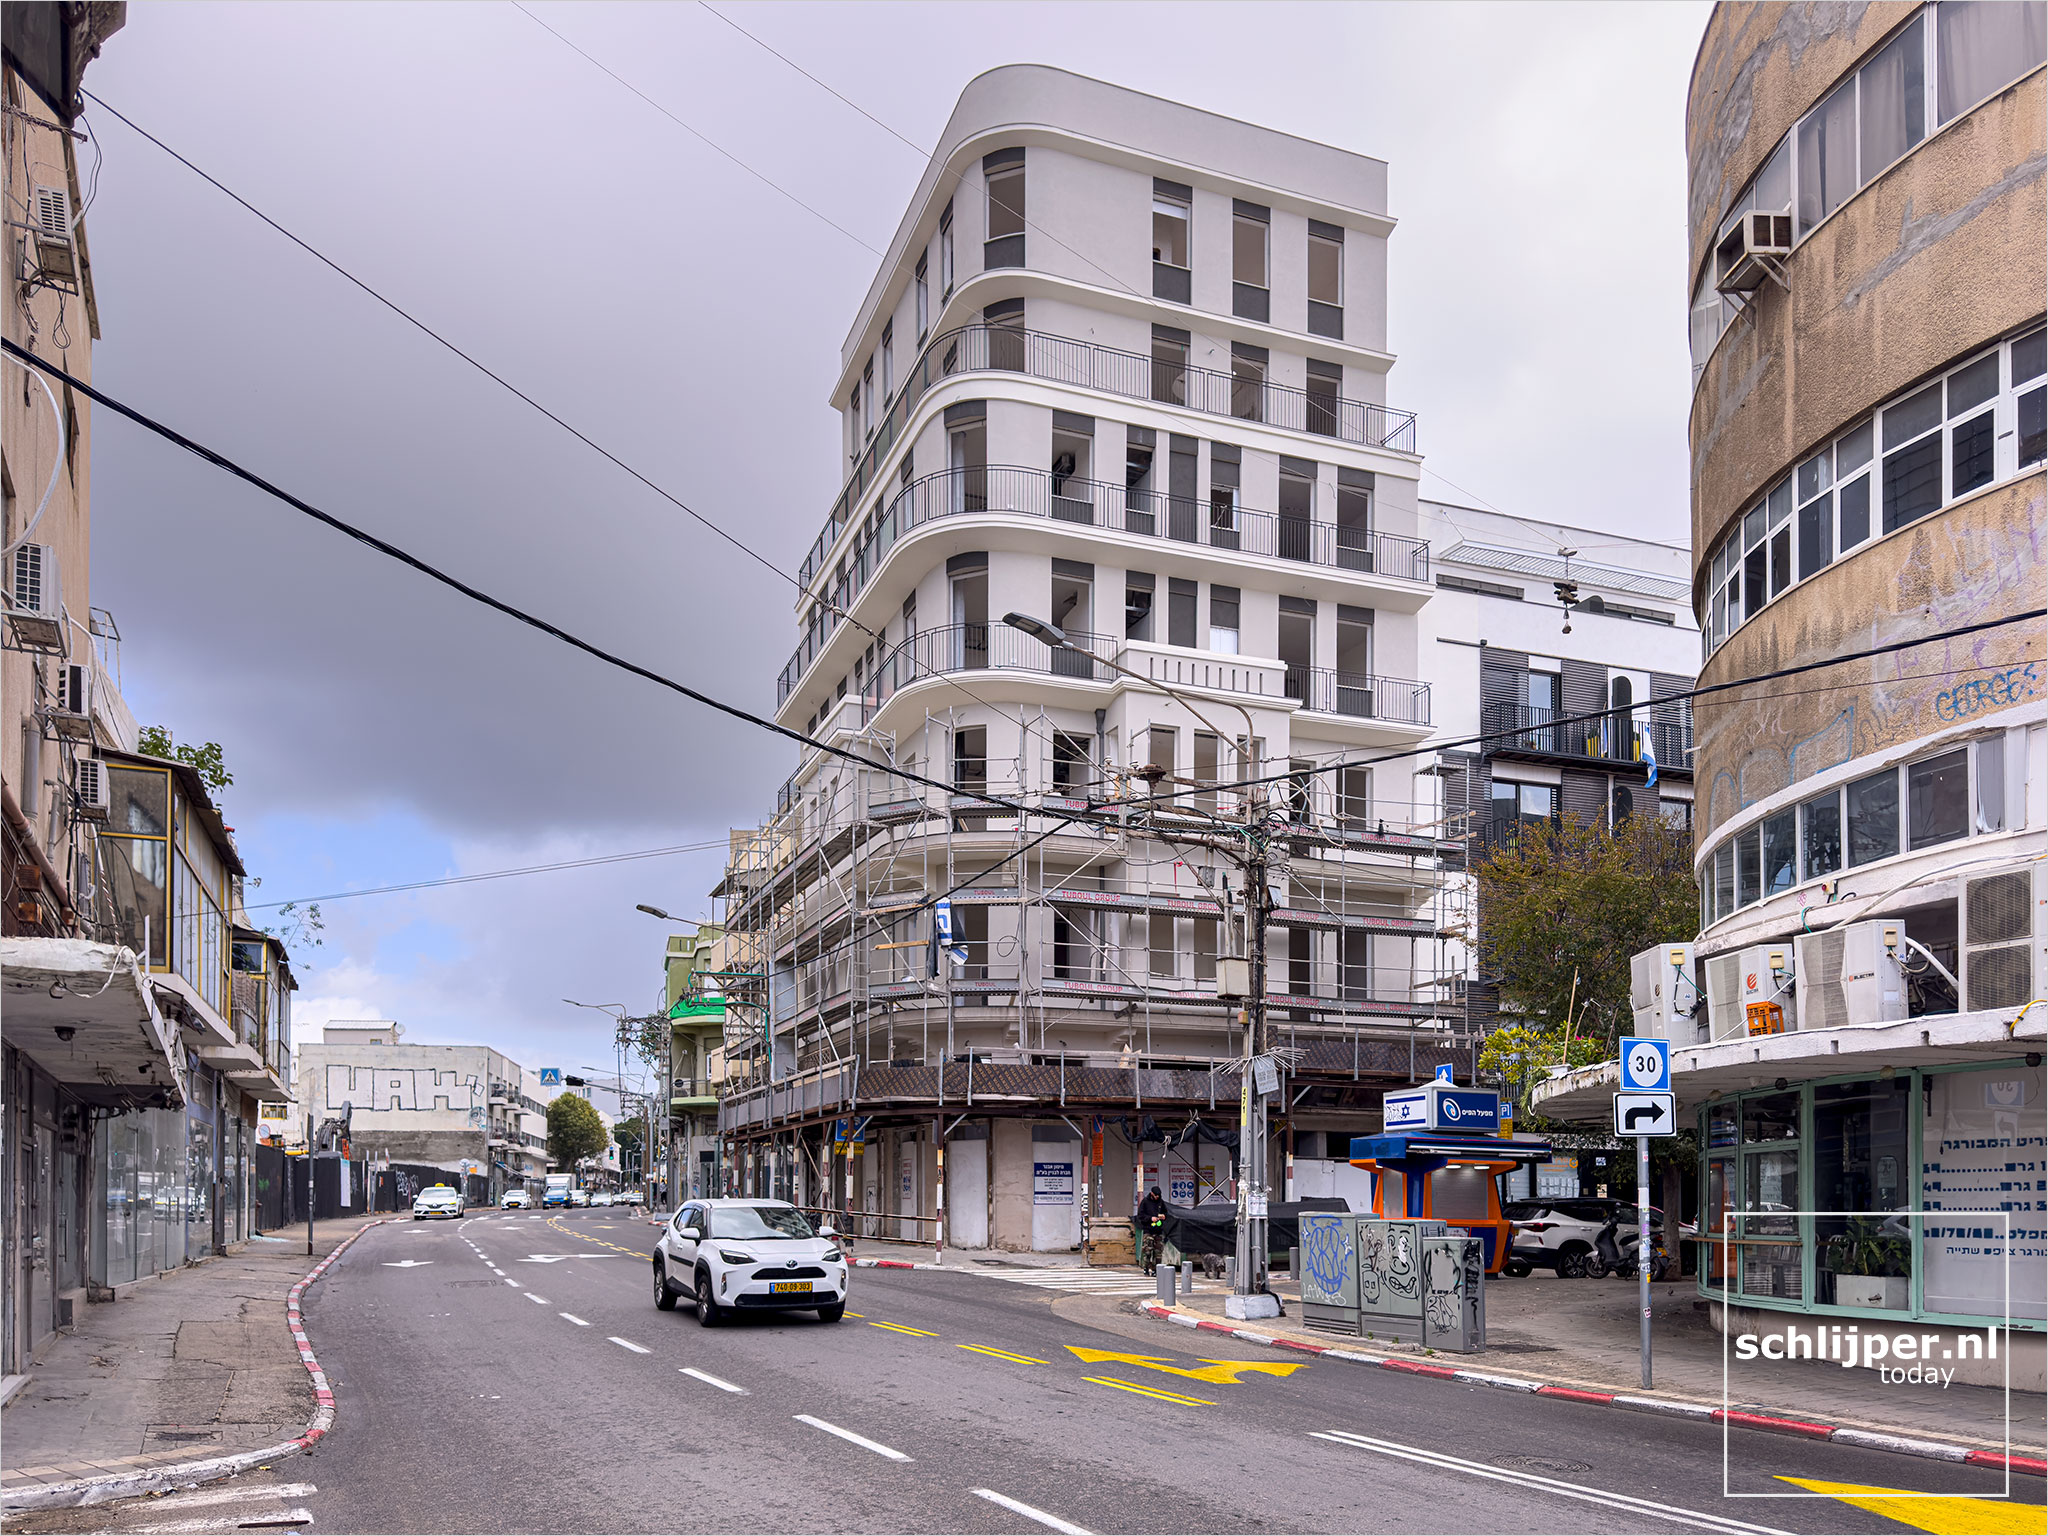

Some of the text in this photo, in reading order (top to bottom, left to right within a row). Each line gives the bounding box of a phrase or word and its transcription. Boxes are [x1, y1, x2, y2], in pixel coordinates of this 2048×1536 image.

[1062, 891, 1121, 902] TUBOUL GROUP
[1064, 982, 1094, 991] TUBOUL
[1635, 1055, 1657, 1073] 30
[1477, 1109, 1494, 1117] מפעל
[1943, 1138, 2011, 1150] המבורגר
[1946, 1246, 1980, 1255] שתייה
